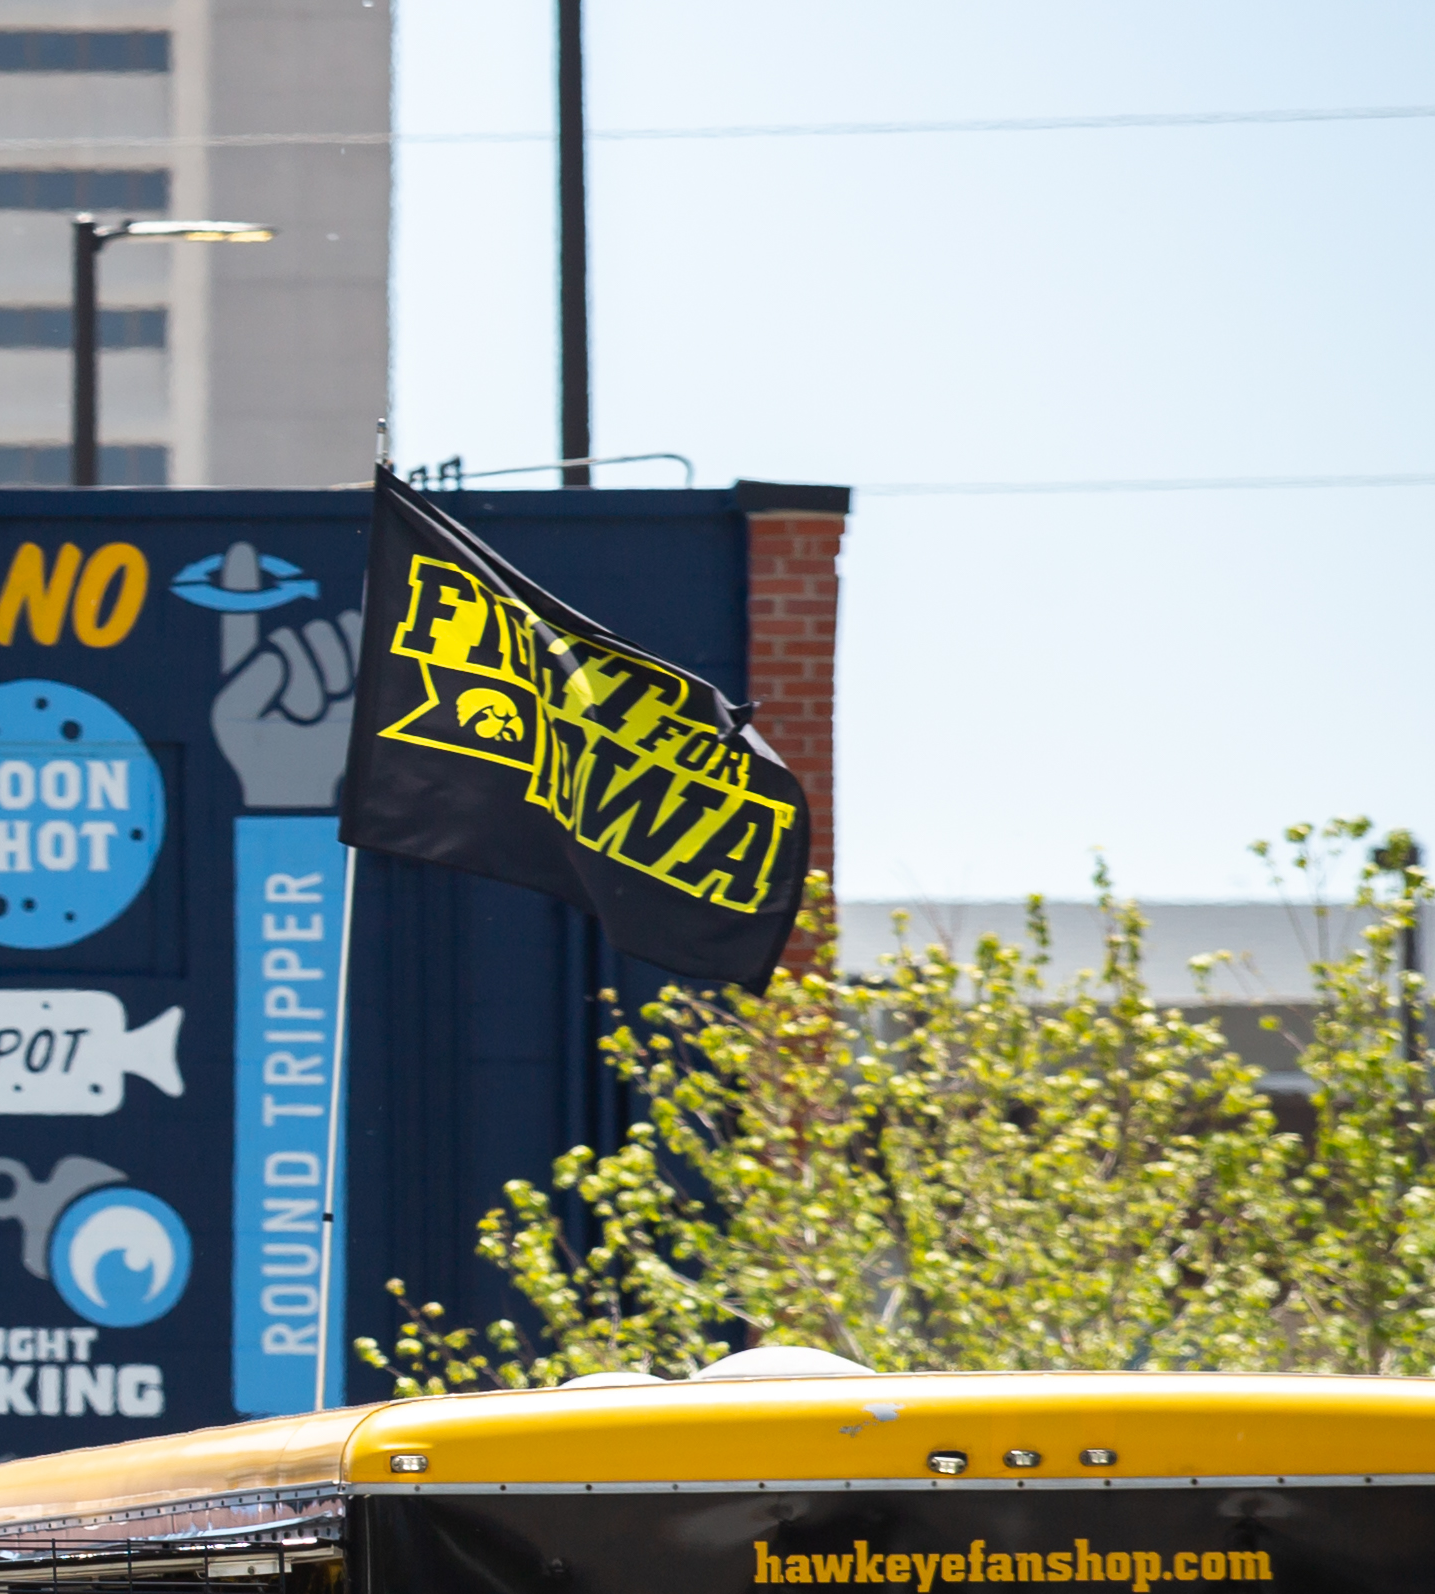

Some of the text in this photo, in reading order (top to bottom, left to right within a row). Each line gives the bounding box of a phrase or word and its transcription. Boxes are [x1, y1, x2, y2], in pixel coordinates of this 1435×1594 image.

[525, 717, 795, 913] IOWA
[636, 714, 750, 791] FOR
[261, 872, 326, 1356] ROUND TRIPPER
[753, 1539, 1273, 1593] hawkeyefanshop.com
